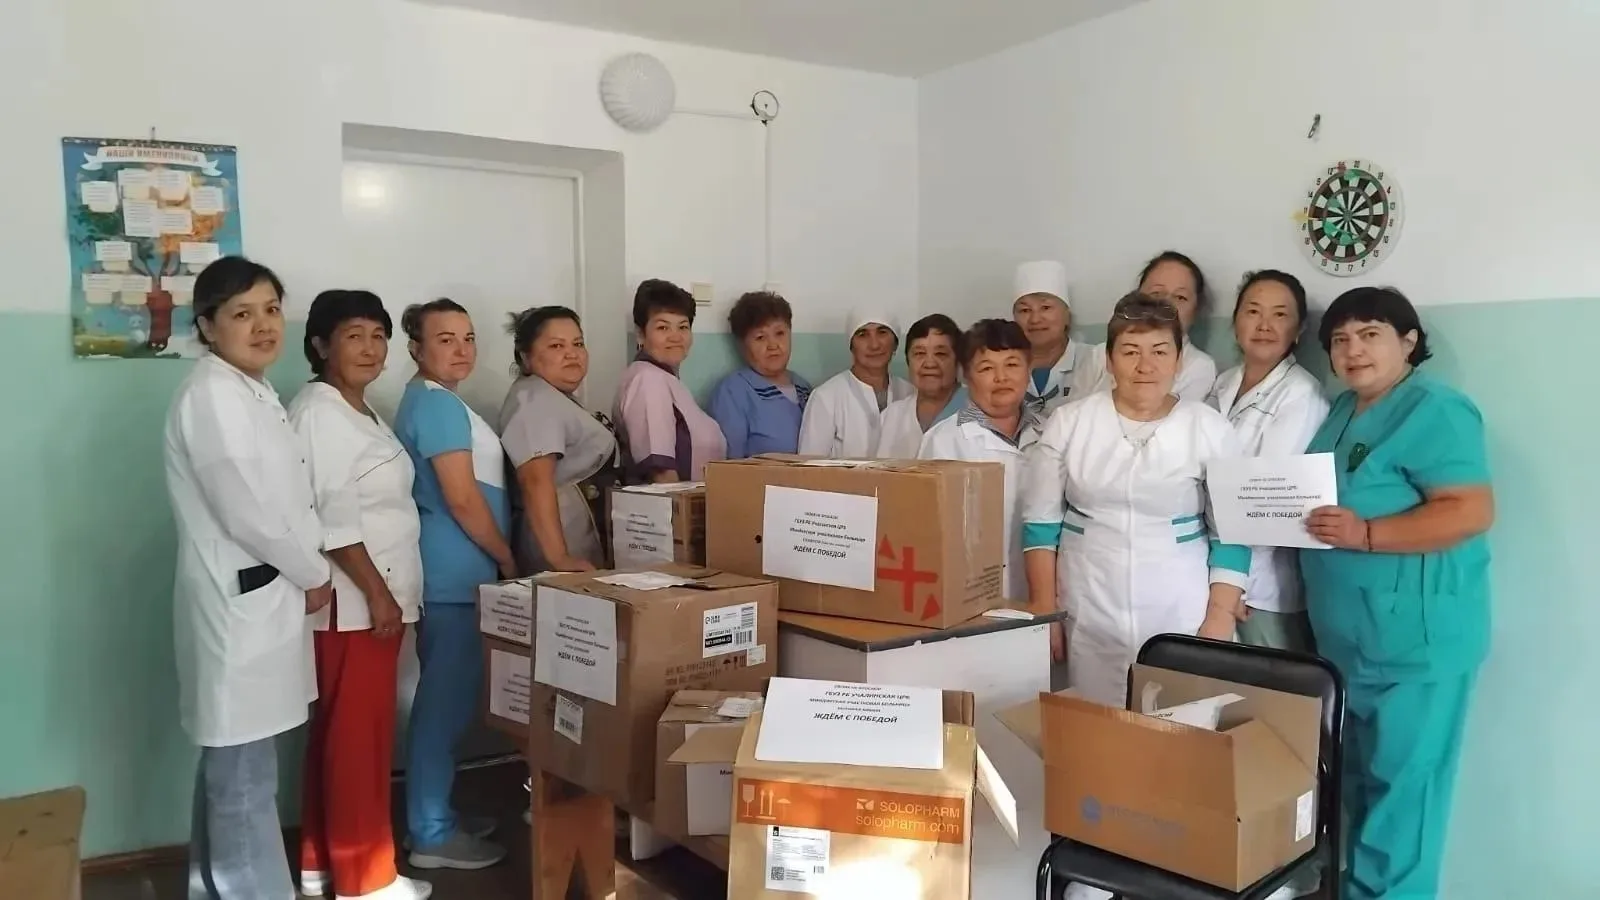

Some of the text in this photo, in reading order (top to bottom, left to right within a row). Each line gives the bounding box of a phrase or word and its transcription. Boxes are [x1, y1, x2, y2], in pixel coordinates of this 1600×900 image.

[817, 549, 846, 559] ПОБЕДОЙ
[814, 712, 844, 720] ЖДЁМ
[853, 714, 898, 723] ПОБЕДОЙ
[880, 800, 960, 818] SOLOPHARM
[855, 815, 960, 834] solopharm.com
